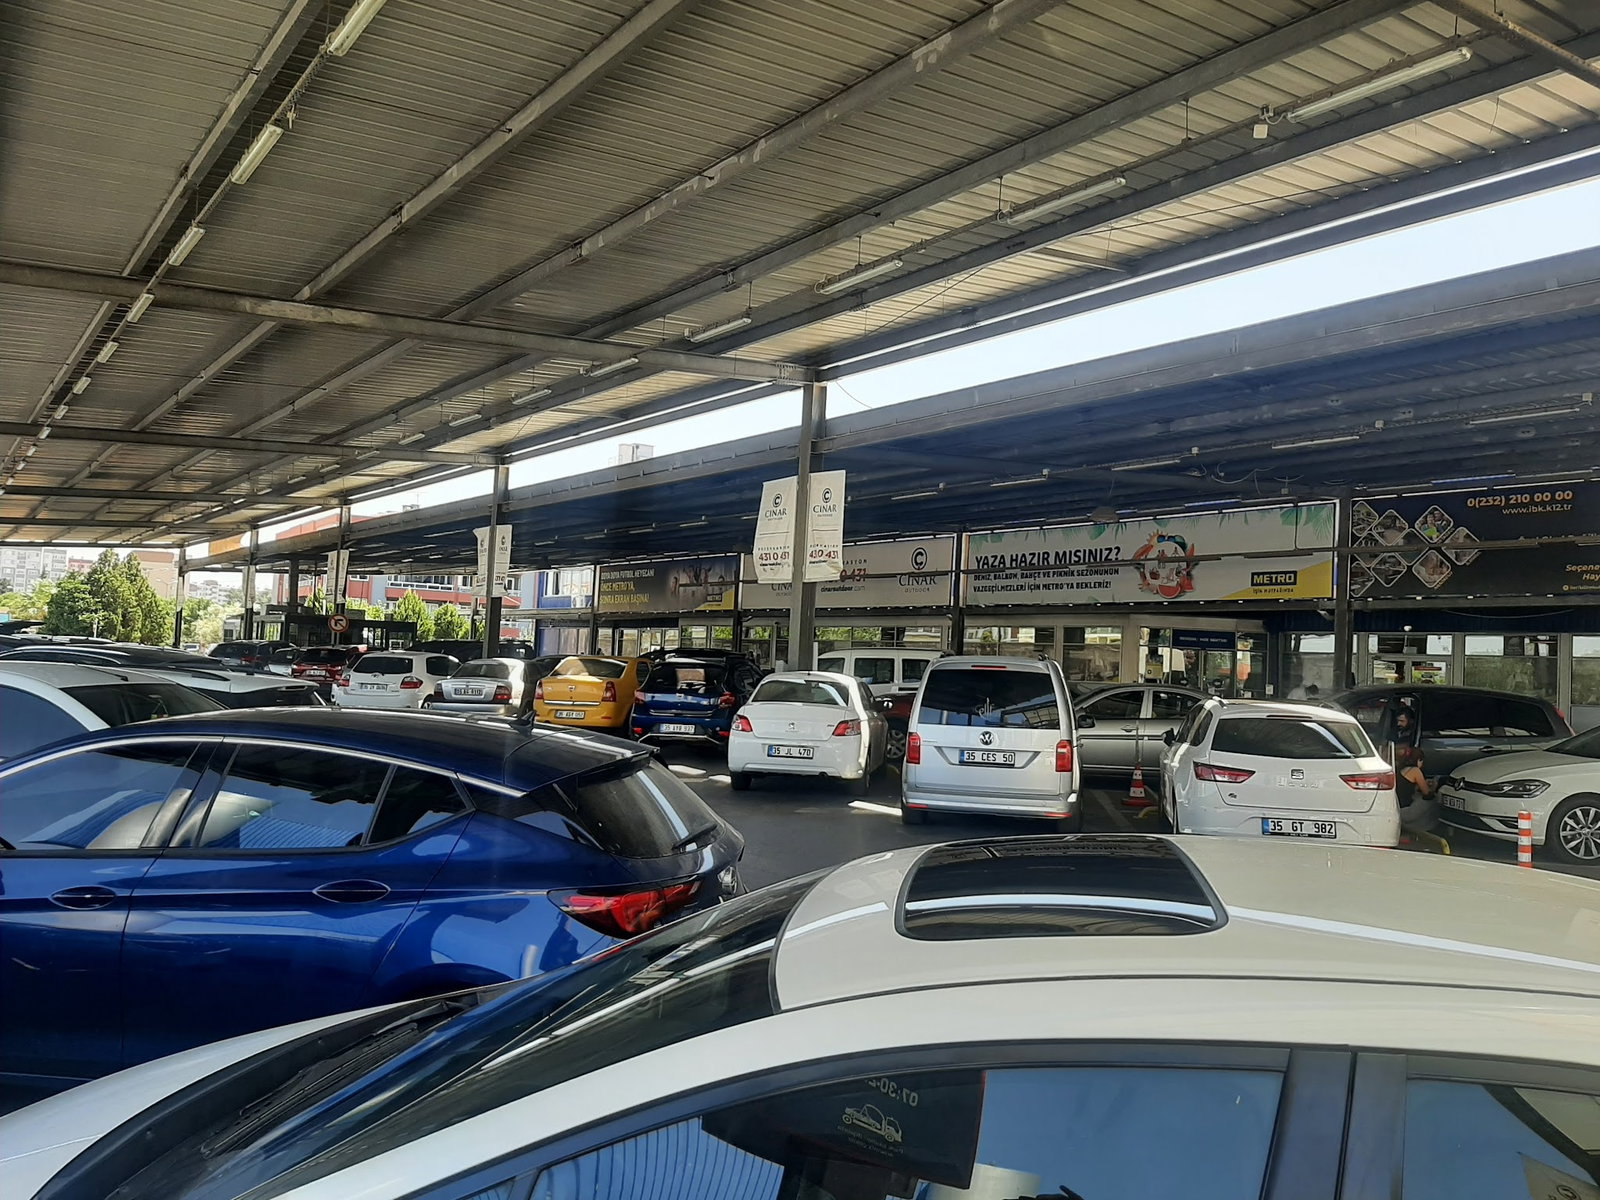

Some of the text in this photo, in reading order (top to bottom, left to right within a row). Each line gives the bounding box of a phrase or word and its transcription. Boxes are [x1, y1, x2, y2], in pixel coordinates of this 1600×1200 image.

[1467, 490, 1573, 508] 0(232) 210 00 00
[1502, 503, 1573, 514] www.ibk.k12.tr
[758, 553, 771, 561] 431
[975, 546, 1121, 570] YAZA HAZIR MISINIZ?
[1043, 570, 1051, 578] VE
[1253, 573, 1295, 584] METRO
[773, 746, 781, 755] 35
[798, 748, 811, 756] 470
[965, 751, 1014, 763] 35 CES 50
[1270, 820, 1283, 832] 35
[1291, 821, 1304, 833] GT
[1313, 822, 1334, 835] 982
